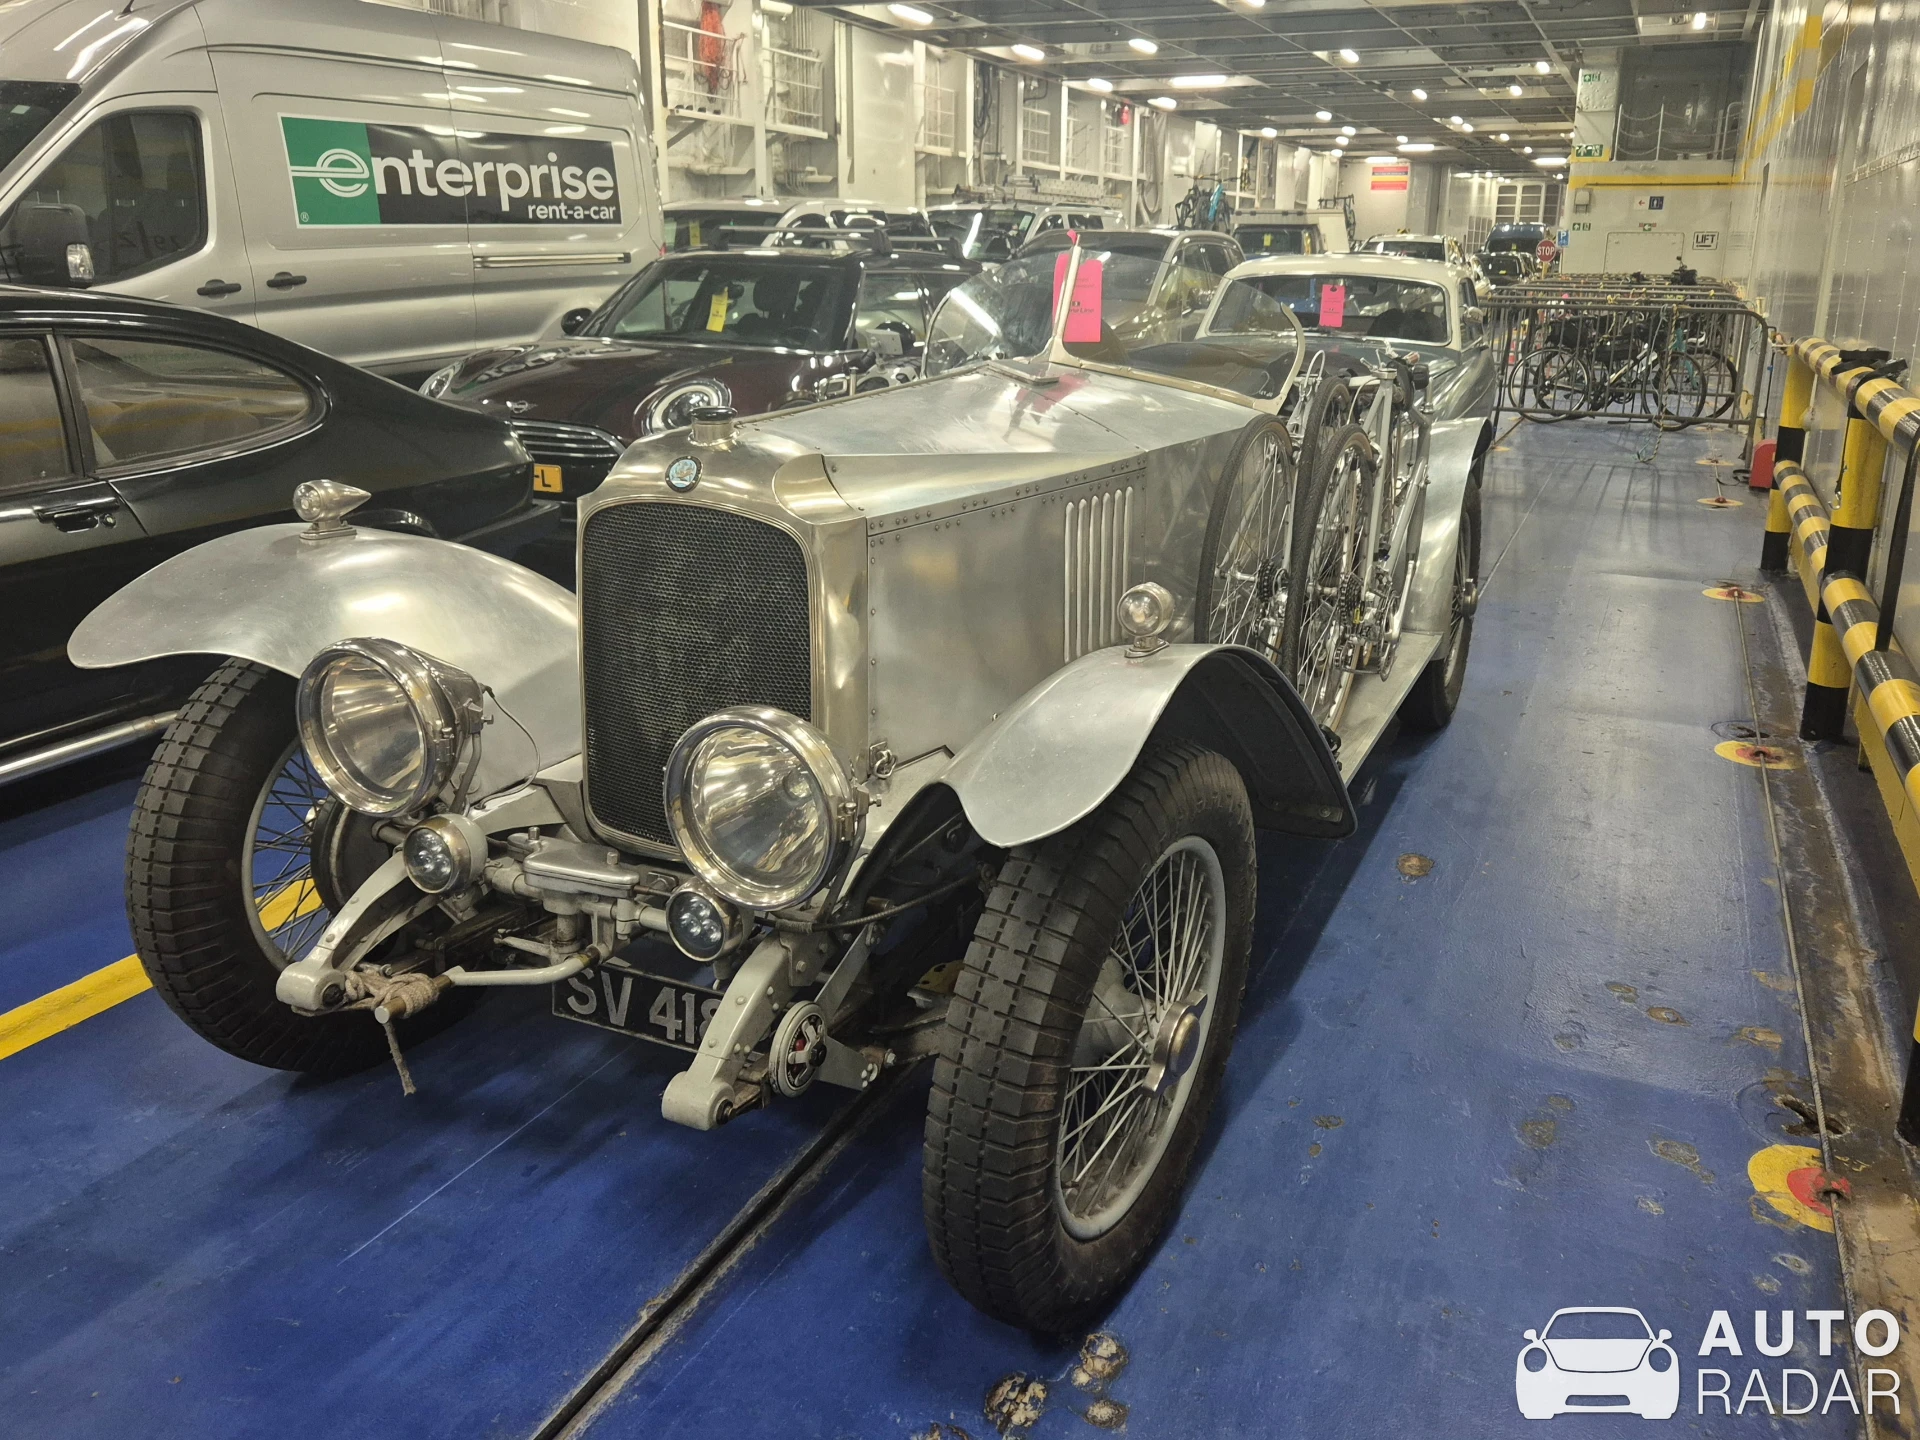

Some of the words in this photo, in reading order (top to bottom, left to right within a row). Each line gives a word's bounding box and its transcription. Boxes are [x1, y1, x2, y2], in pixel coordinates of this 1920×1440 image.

[300, 148, 614, 212] enterprise
[527, 202, 616, 220] rent-a-car
[1695, 234, 1716, 245] LIFT
[1537, 246, 1555, 256] STOP
[567, 968, 632, 1026] SV
